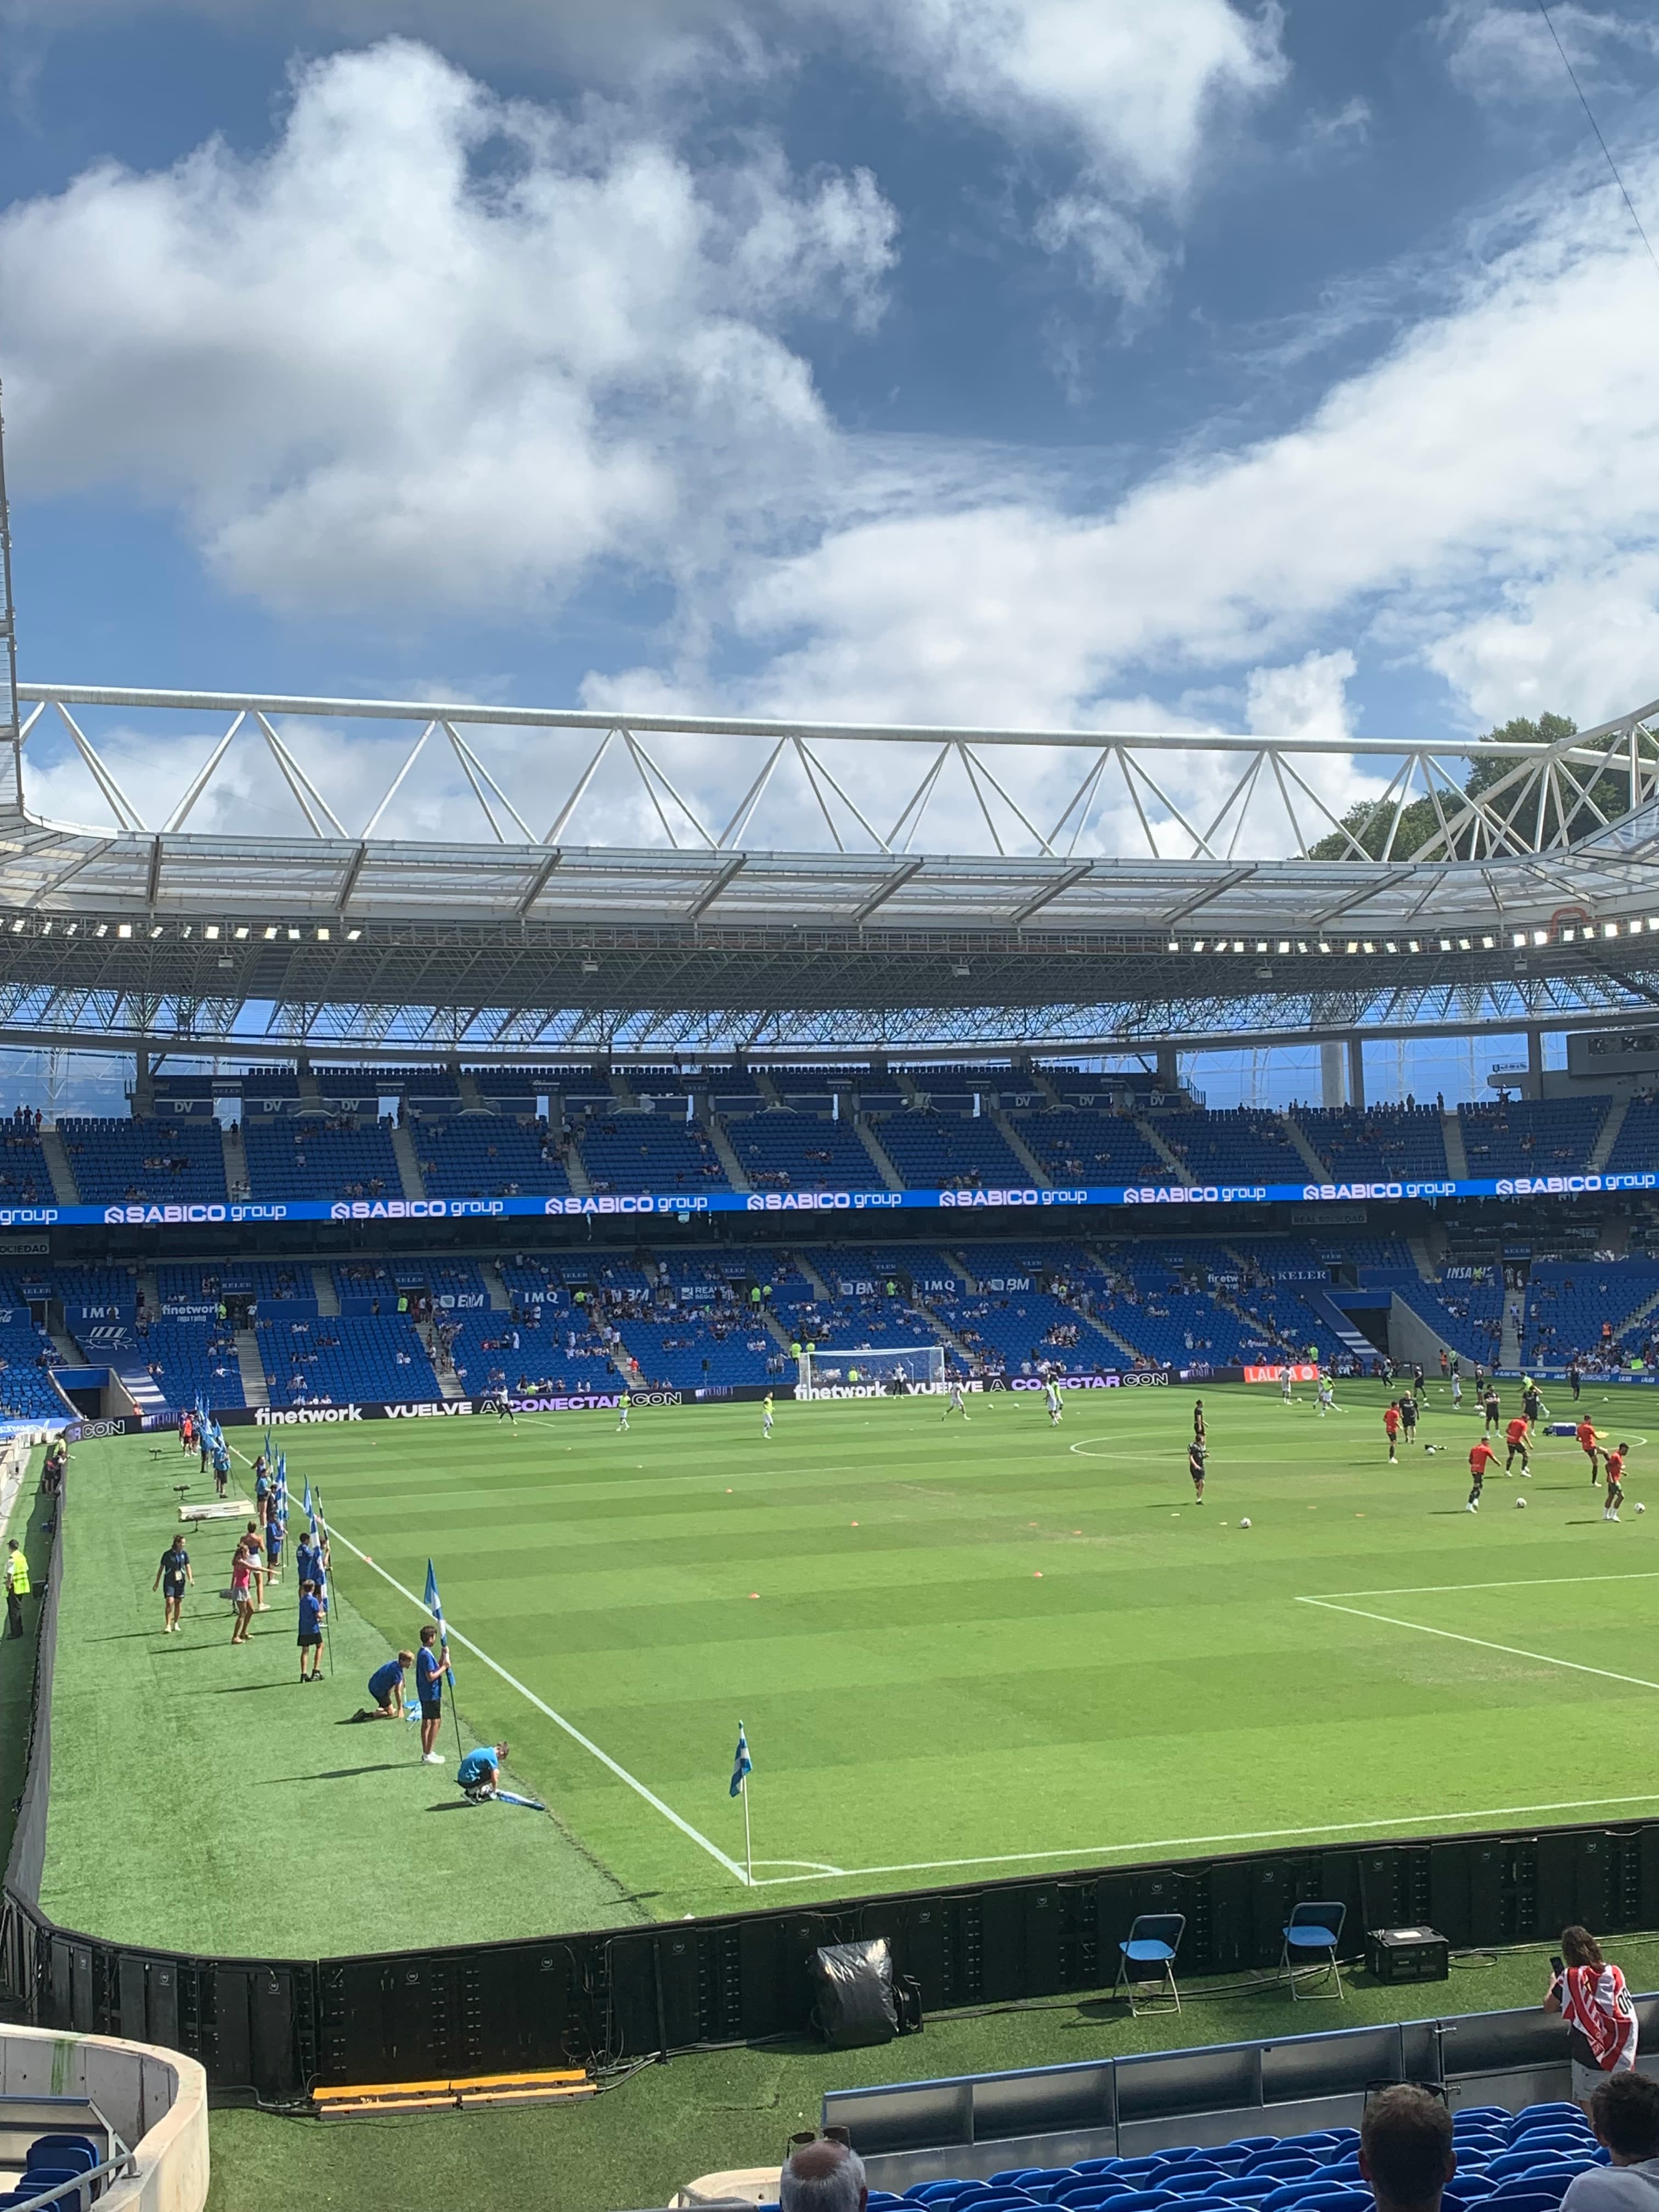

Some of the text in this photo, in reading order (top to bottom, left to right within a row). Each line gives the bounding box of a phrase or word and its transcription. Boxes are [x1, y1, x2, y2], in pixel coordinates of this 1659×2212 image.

[174, 1101, 193, 1113] DV
[263, 1101, 281, 1112] DV
[341, 1101, 359, 1111] DV
[1015, 1096, 1030, 1107] DV
[1079, 1096, 1094, 1106] DV
[1150, 1096, 1165, 1105] DV
[1321, 1183, 1455, 1199] SABICO group
[1515, 1175, 1655, 1194] SABICO group
[766, 1193, 901, 1210] SABICO group
[957, 1190, 1087, 1206] SABICO group
[1141, 1187, 1265, 1203] SABICO group
[353, 1201, 503, 1218] SABICO group
[565, 1197, 707, 1214] SABICO group
[0, 1210, 58, 1225] group
[127, 1205, 286, 1223] SABICO group
[1278, 1271, 1327, 1280] KELER
[924, 1280, 956, 1292] IMQ
[1006, 1278, 1030, 1291] BM
[524, 1291, 559, 1304] IMQ
[1249, 1367, 1298, 1382] LALIA
[794, 1373, 1169, 1401] finetwork VUEVE A COECTAR CON
[255, 1403, 363, 1426] finetwork
[384, 1401, 473, 1419] VUELVE
[632, 1392, 682, 1407] CON
[83, 1420, 125, 1439] CON
